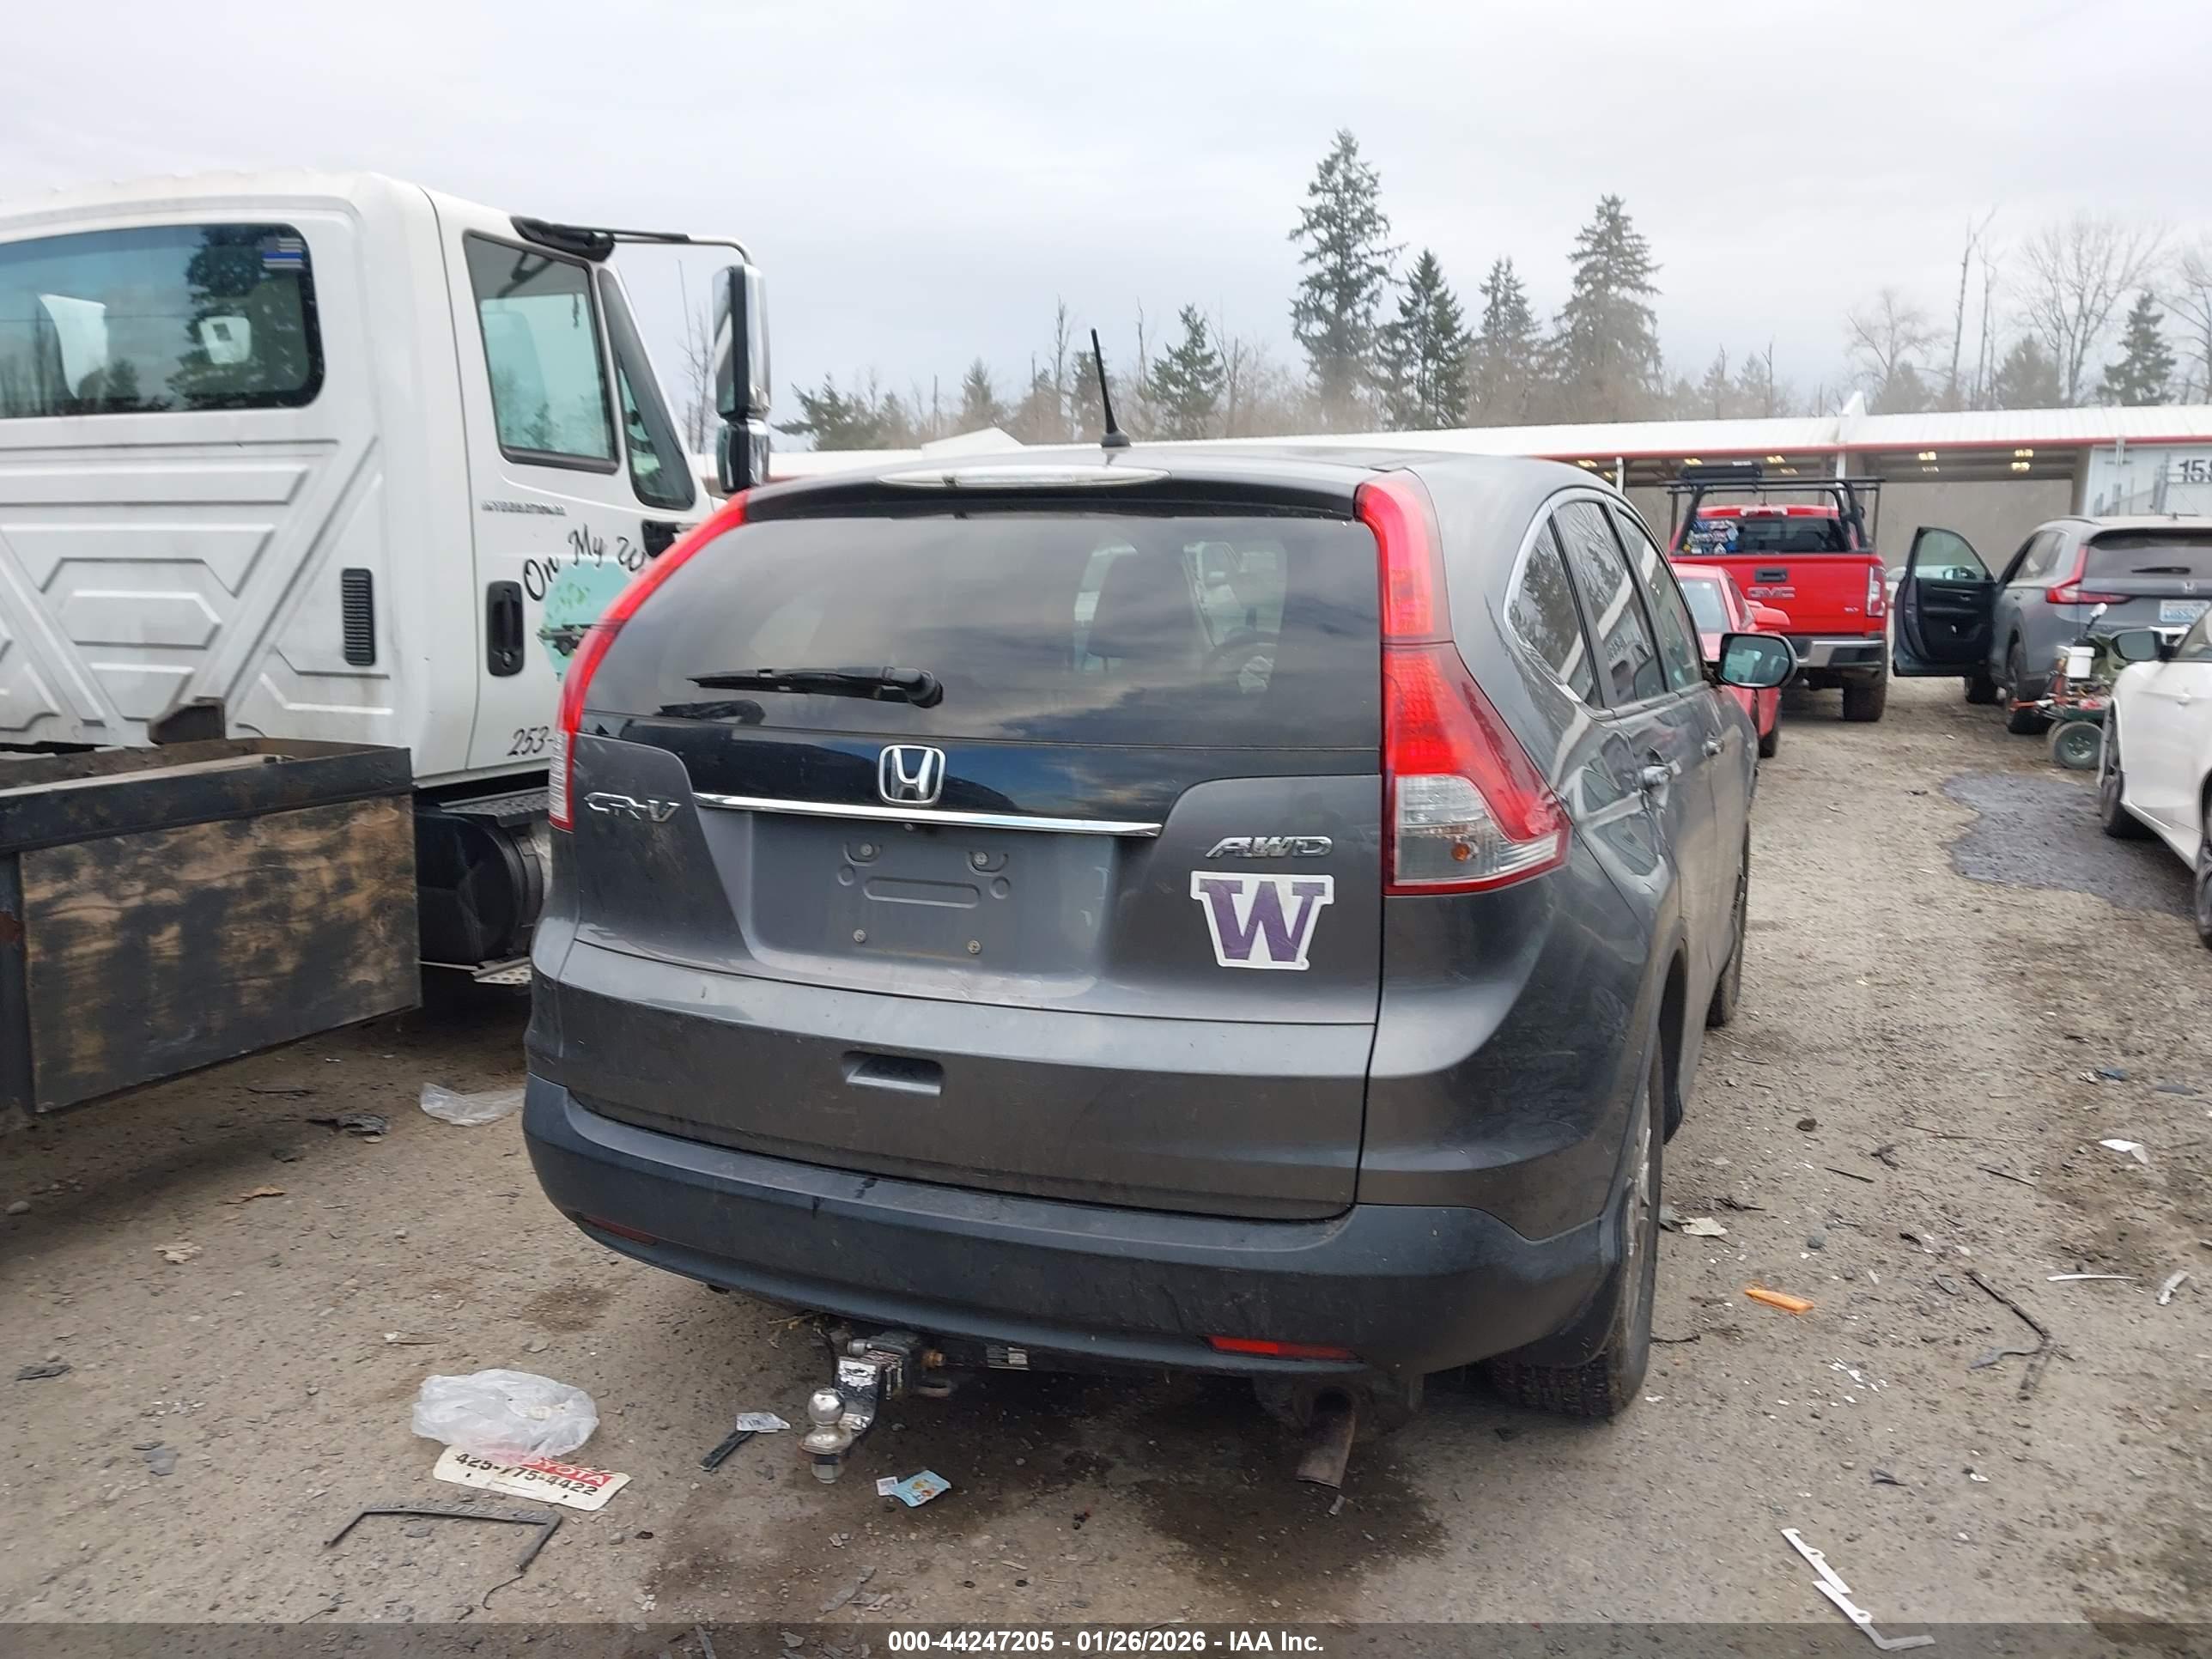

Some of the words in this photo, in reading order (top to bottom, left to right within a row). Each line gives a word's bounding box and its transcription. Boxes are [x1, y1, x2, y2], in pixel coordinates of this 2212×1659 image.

[523, 556, 560, 602] On
[568, 523, 606, 568] My
[616, 536, 647, 574] W
[1747, 586, 1796, 599] GMC
[583, 792, 681, 823] CR-V
[1205, 836, 1333, 858] AWD
[1199, 878, 1326, 963] W
[536, 1458, 605, 1486] YOTA
